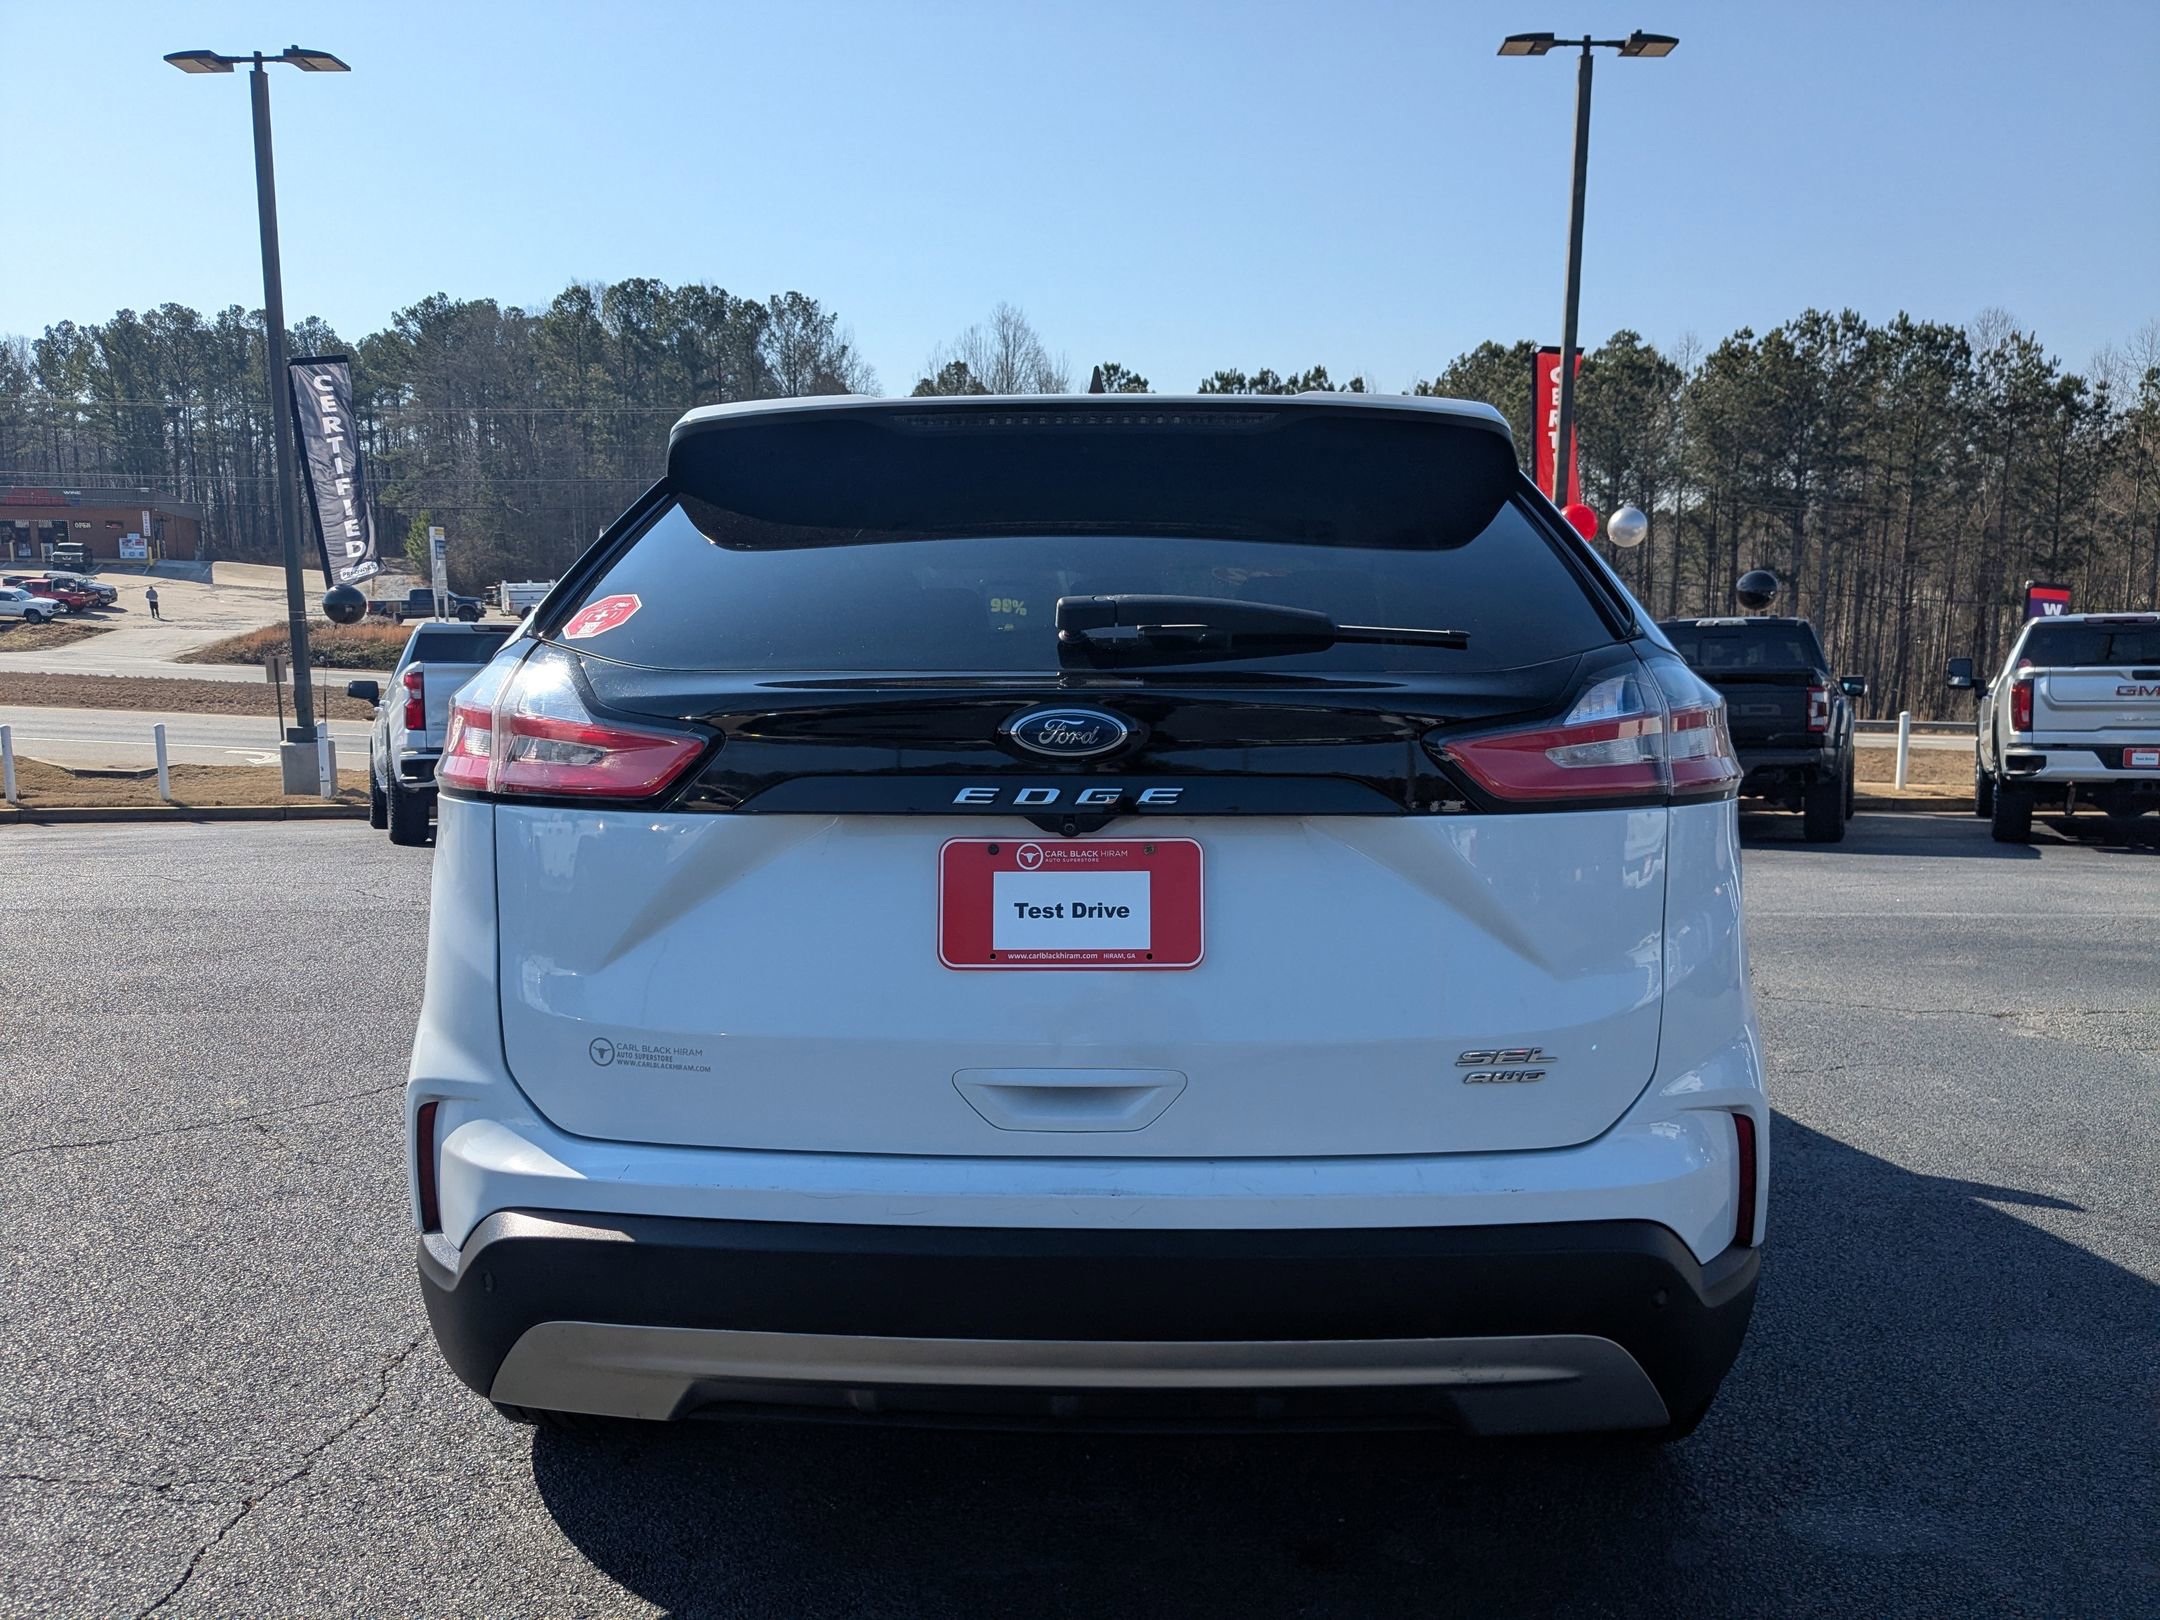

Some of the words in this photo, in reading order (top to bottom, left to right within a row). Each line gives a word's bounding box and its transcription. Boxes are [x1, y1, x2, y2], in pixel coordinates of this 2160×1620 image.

[313, 374, 366, 558] CERTIFIED
[2042, 602, 2063, 616] W
[1038, 718, 1100, 745] Ford
[952, 787, 1184, 806] EDGE
[1044, 850, 1067, 858] CARL
[1070, 850, 1098, 858] BLACK
[1100, 849, 1128, 857] HIRAM
[1013, 902, 1064, 920] Test
[1071, 901, 1131, 920] Drive
[1007, 952, 1098, 960] www.carlblackhiram.com
[616, 1042, 639, 1052] CARL
[641, 1044, 672, 1054] BLACK
[673, 1047, 703, 1057] HIRAM
[616, 1051, 633, 1059] AUTO
[634, 1053, 673, 1063] SUPERSTORE
[1455, 1047, 1558, 1067] SEL
[616, 1058, 711, 1073] WWW.CARLBLACKHIRAM.COM
[1464, 1068, 1546, 1084] AWD
